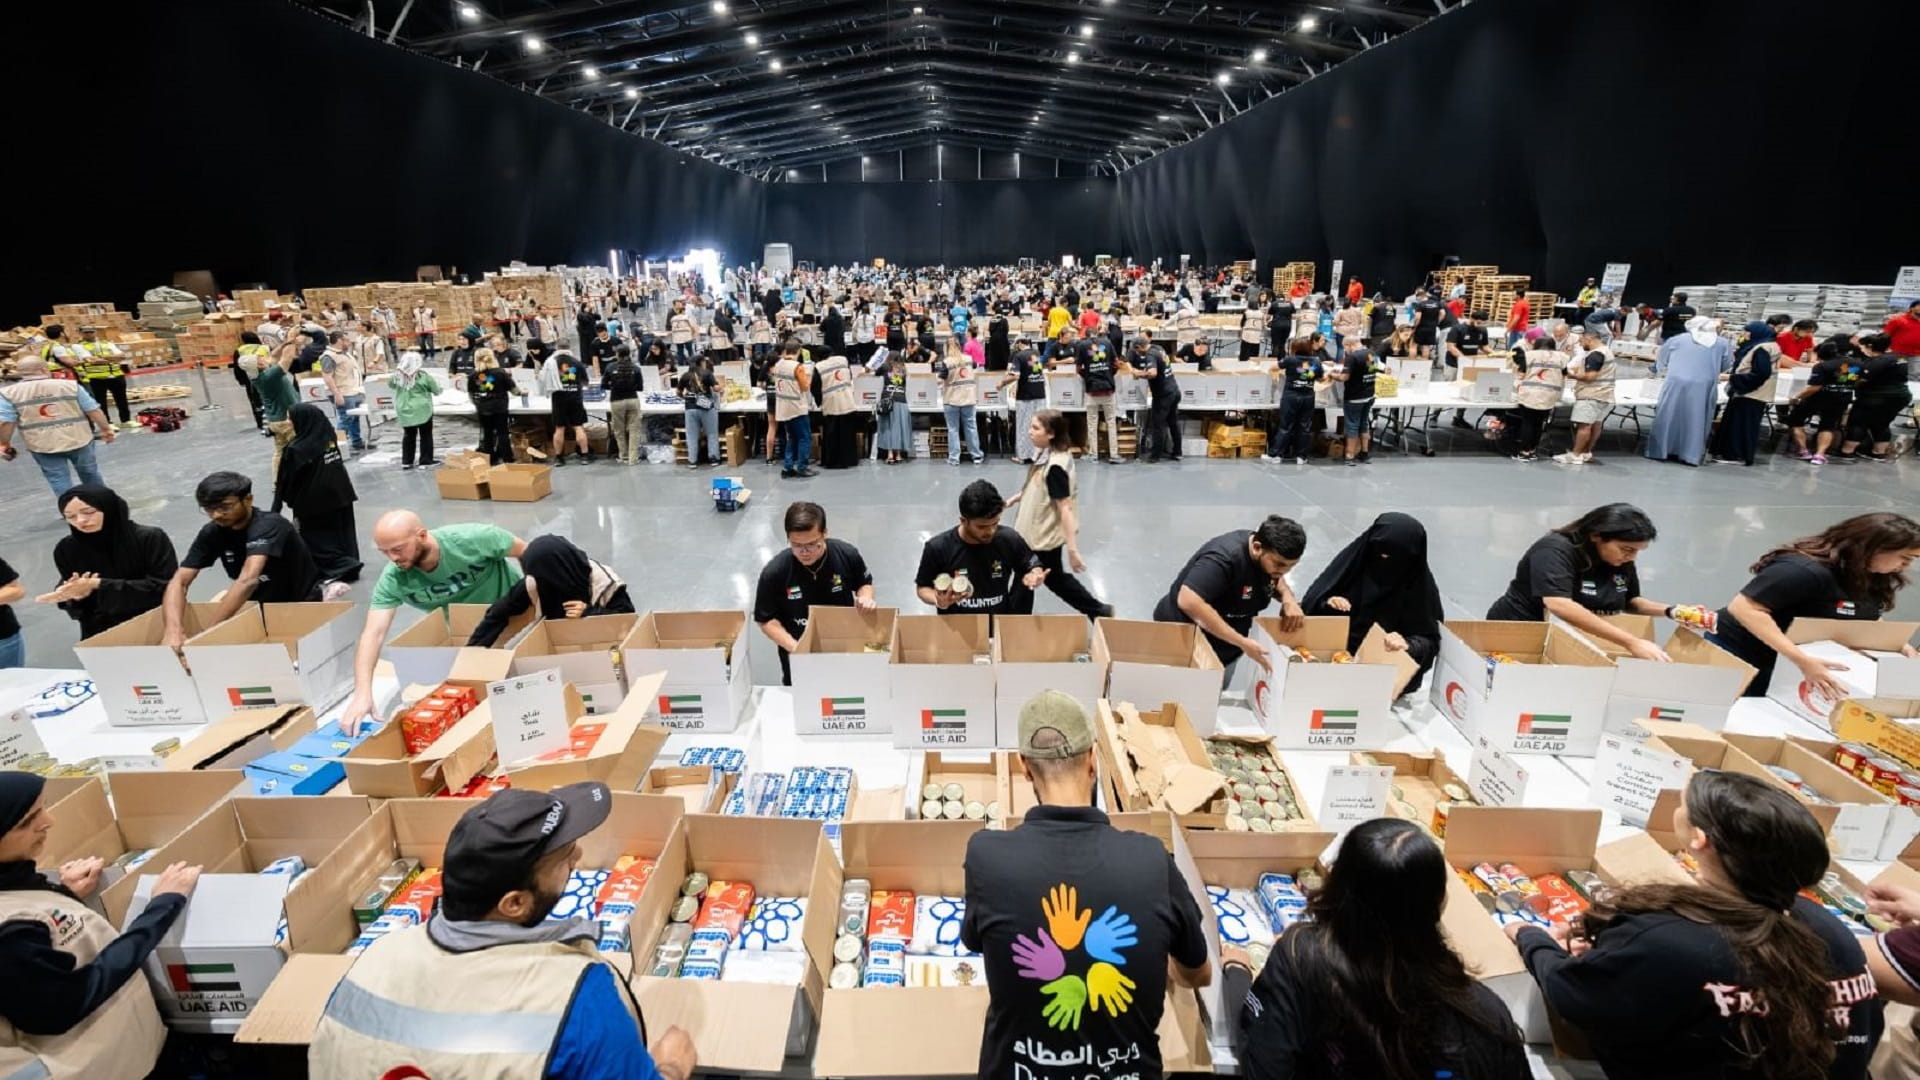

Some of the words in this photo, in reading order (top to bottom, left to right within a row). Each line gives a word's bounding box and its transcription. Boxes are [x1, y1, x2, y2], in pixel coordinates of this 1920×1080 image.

[685, 720, 704, 729] AID
[822, 722, 846, 730] UAE
[847, 721, 866, 729] AID
[922, 735, 946, 743] UAE
[947, 735, 967, 743] AID
[1308, 735, 1332, 745] UAE
[1335, 736, 1355, 745] AID
[1513, 740, 1541, 750] UAE
[1542, 741, 1566, 751] AID
[180, 1001, 215, 1013] UAE
[218, 1000, 248, 1012] AID
[1013, 1036, 1093, 1066] العطاء
[1097, 1042, 1140, 1072] دبي
